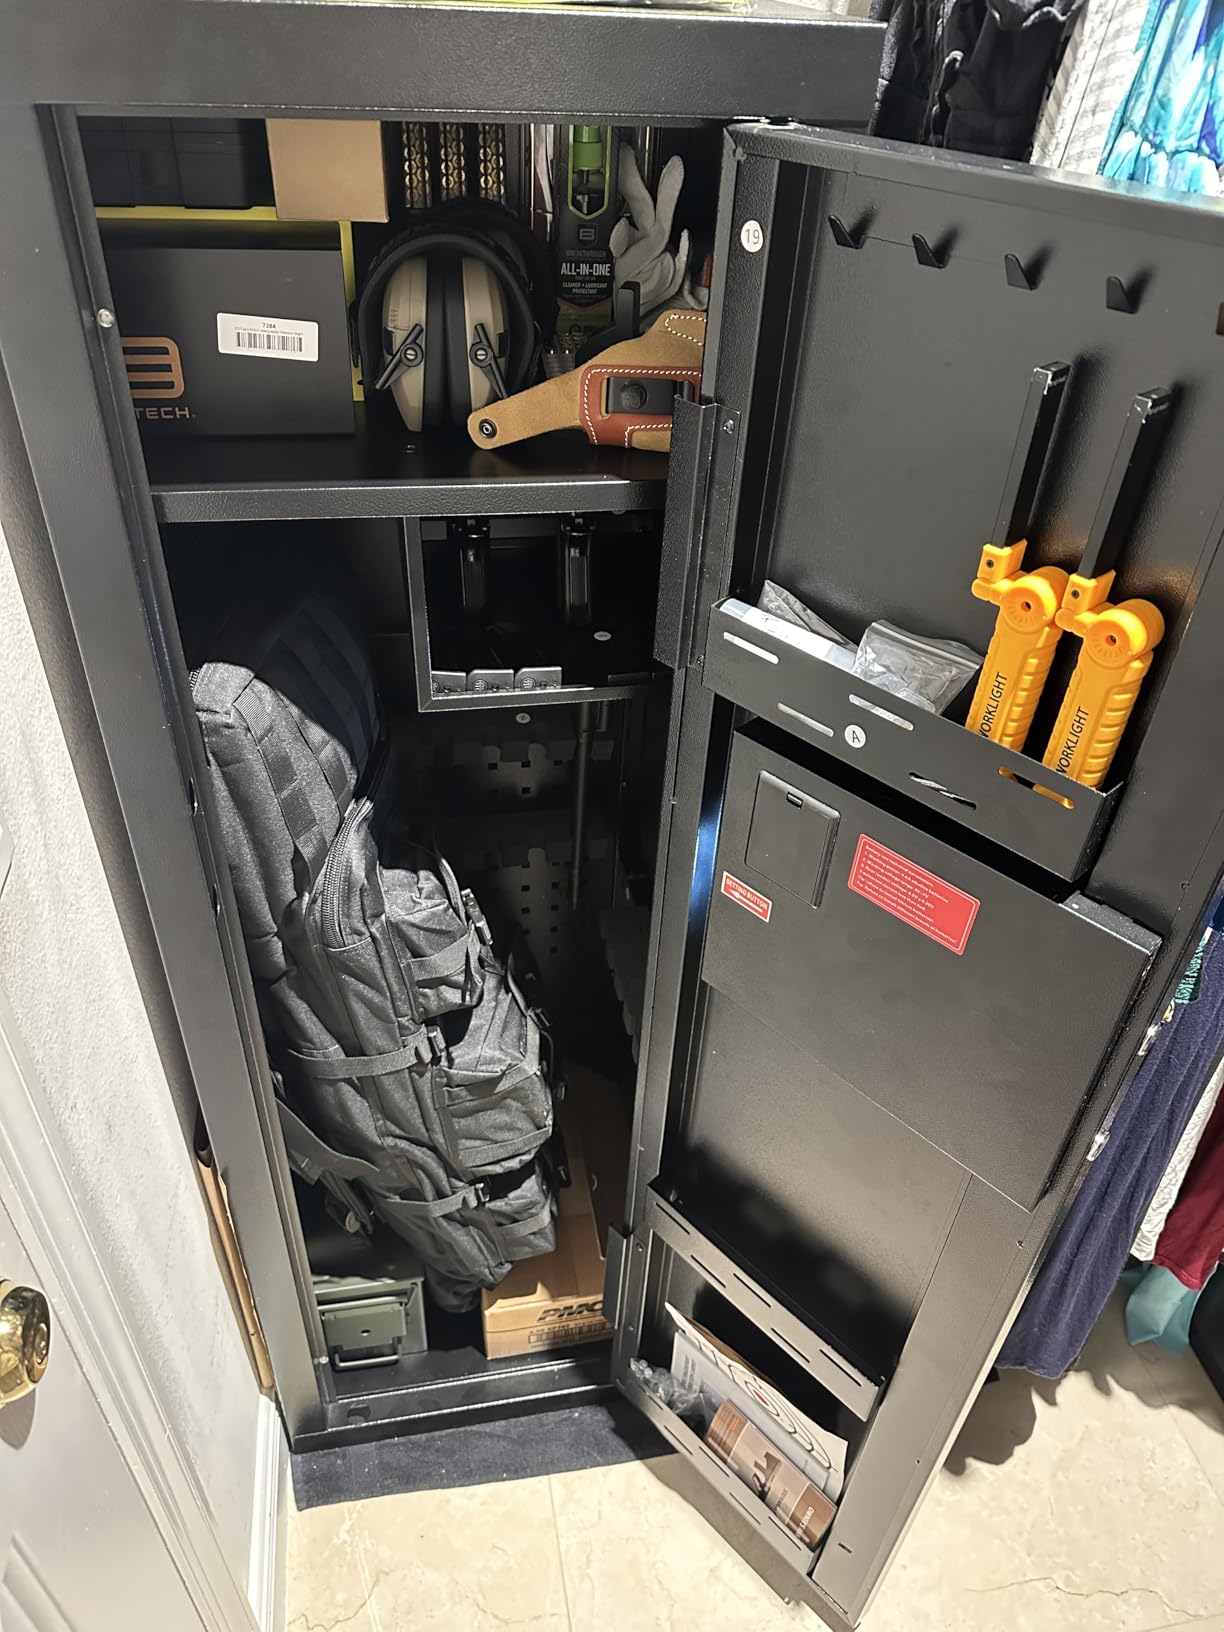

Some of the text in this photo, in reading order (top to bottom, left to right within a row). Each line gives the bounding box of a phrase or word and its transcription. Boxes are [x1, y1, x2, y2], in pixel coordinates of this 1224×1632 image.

[745, 229, 760, 245] 19
[561, 262, 611, 276] ALL-IN-ONE
[852, 730, 861, 743] A
[746, 891, 768, 910] BUTTON
